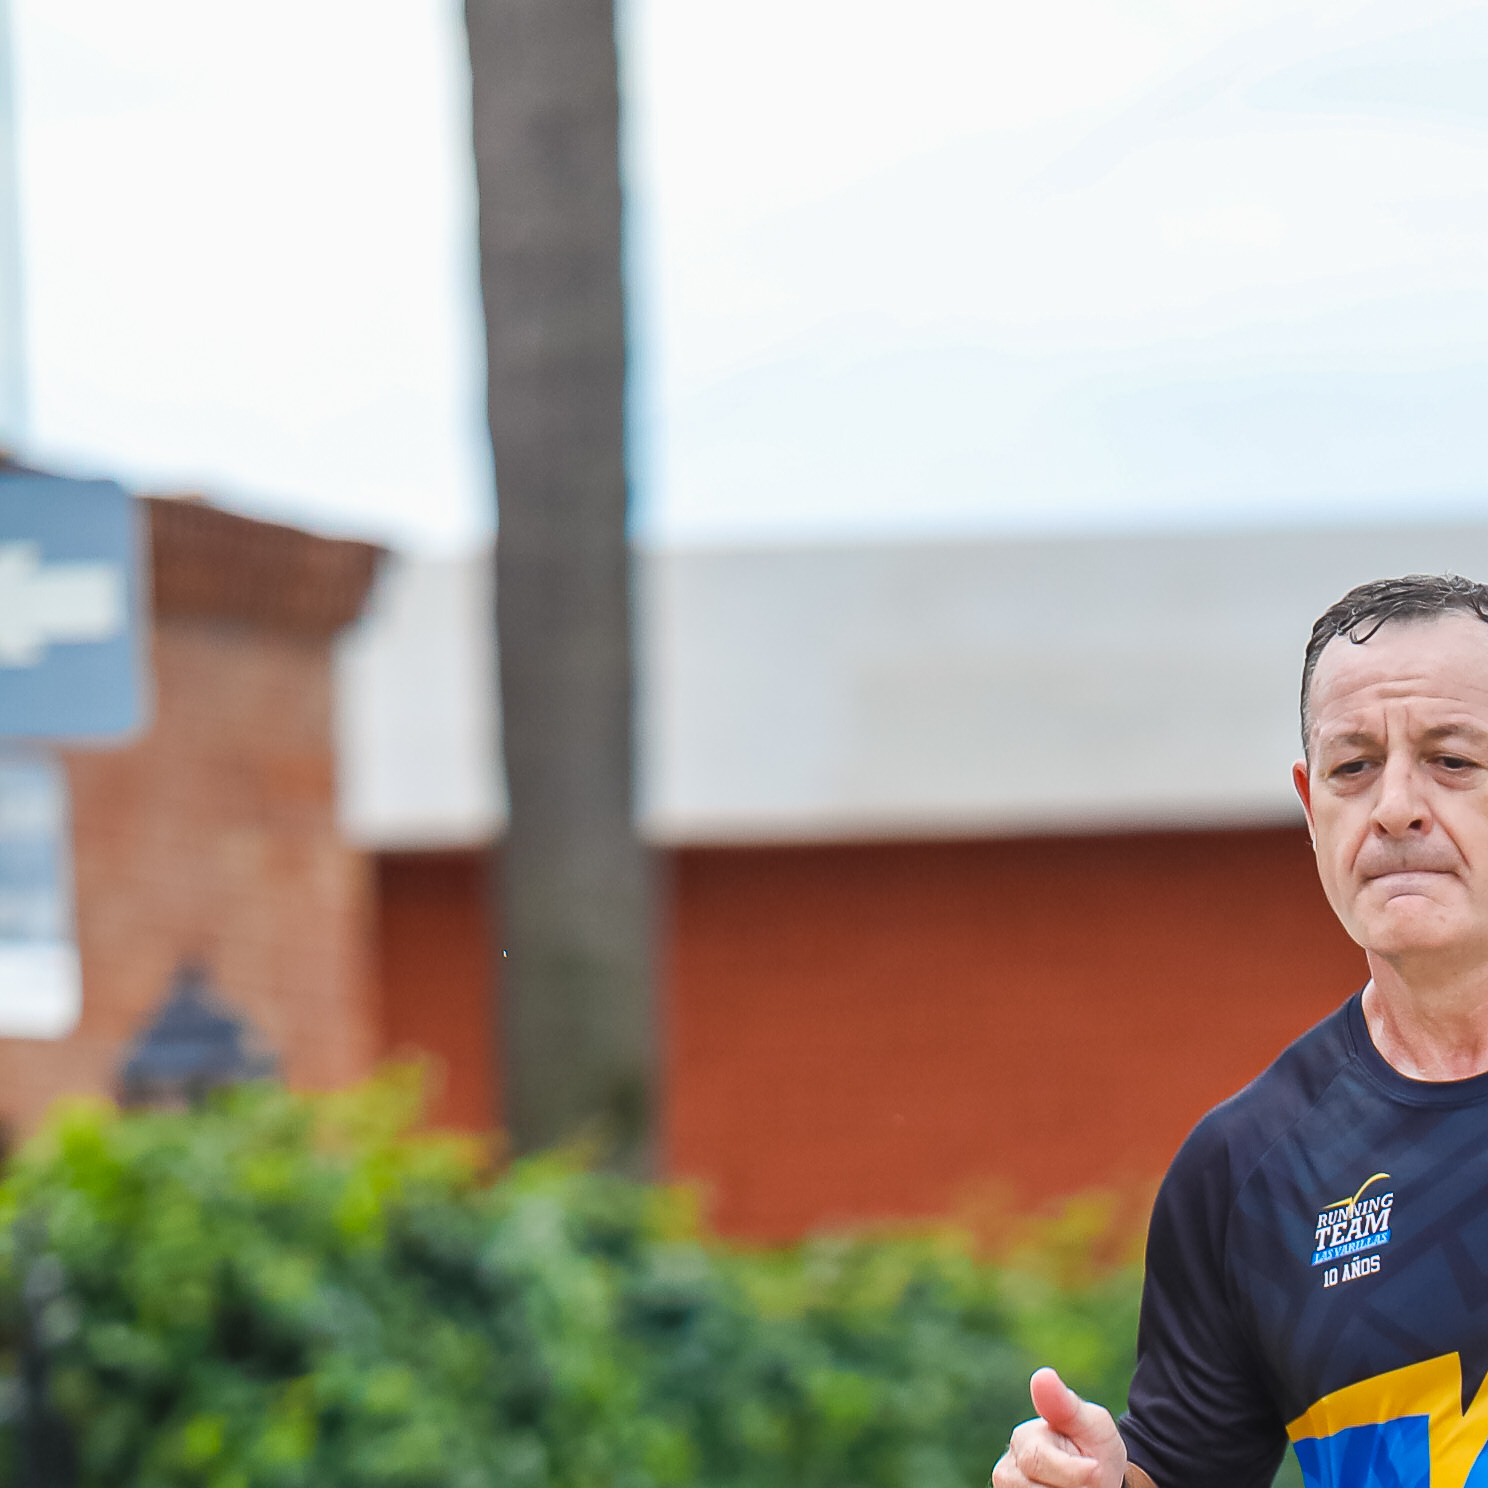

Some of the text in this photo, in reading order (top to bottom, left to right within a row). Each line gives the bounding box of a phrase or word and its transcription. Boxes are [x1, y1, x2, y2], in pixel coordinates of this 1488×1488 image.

[1316, 1192, 1394, 1229] RUNNING
[1315, 1207, 1391, 1251] TEAM
[1314, 1249, 1334, 1263] LAS
[1323, 1255, 1381, 1288] 10 AÑOS
